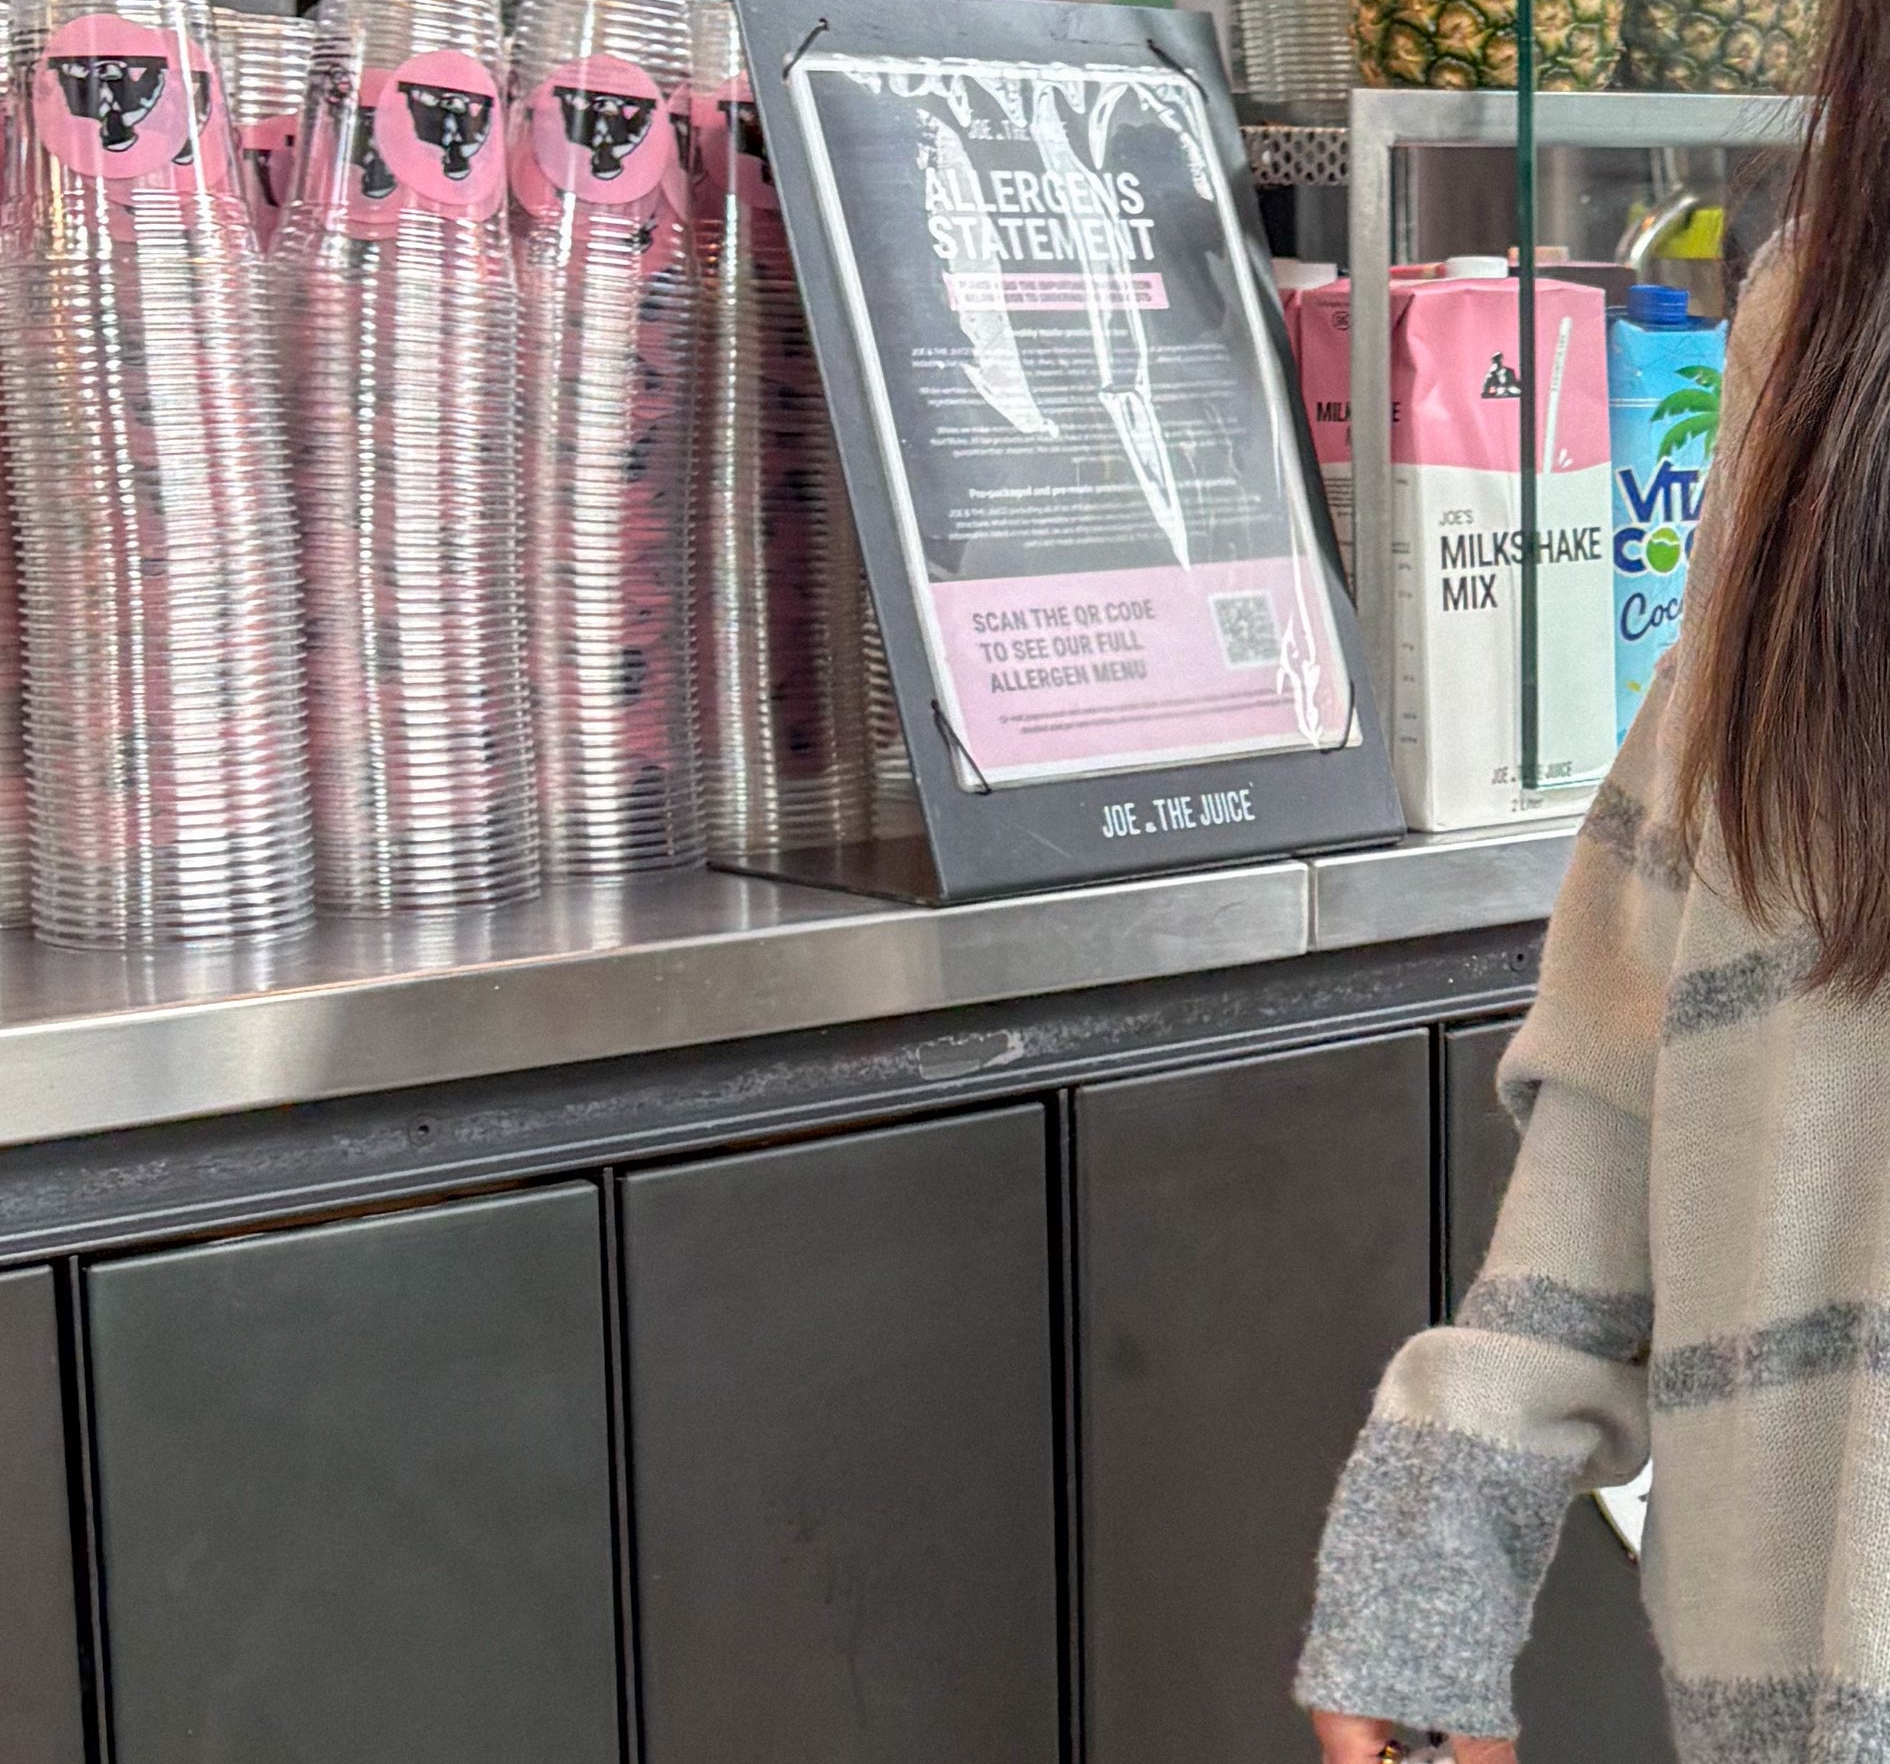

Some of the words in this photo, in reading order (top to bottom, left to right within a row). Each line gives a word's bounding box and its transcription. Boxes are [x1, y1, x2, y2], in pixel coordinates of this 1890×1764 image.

[924, 166, 1145, 215] ALLERGENS
[927, 215, 1156, 261] STATEMENT
[1439, 510, 1475, 527] JOE'S
[1442, 574, 1499, 613] MIX
[972, 611, 1027, 634] SCAN
[1030, 606, 1071, 630] THE
[1074, 602, 1103, 626] QR
[1105, 599, 1156, 624] CODE
[1620, 592, 1684, 641] Coc
[979, 641, 1008, 665] TO
[1013, 637, 1050, 661] SEE
[1052, 634, 1094, 659] OUR
[1098, 630, 1145, 654] FULL
[990, 664, 1090, 694] ALLERGEN
[1093, 659, 1148, 684] MENU
[1102, 802, 1141, 839] JOE
[1152, 796, 1197, 832] THE
[1199, 788, 1256, 827] JUICE
